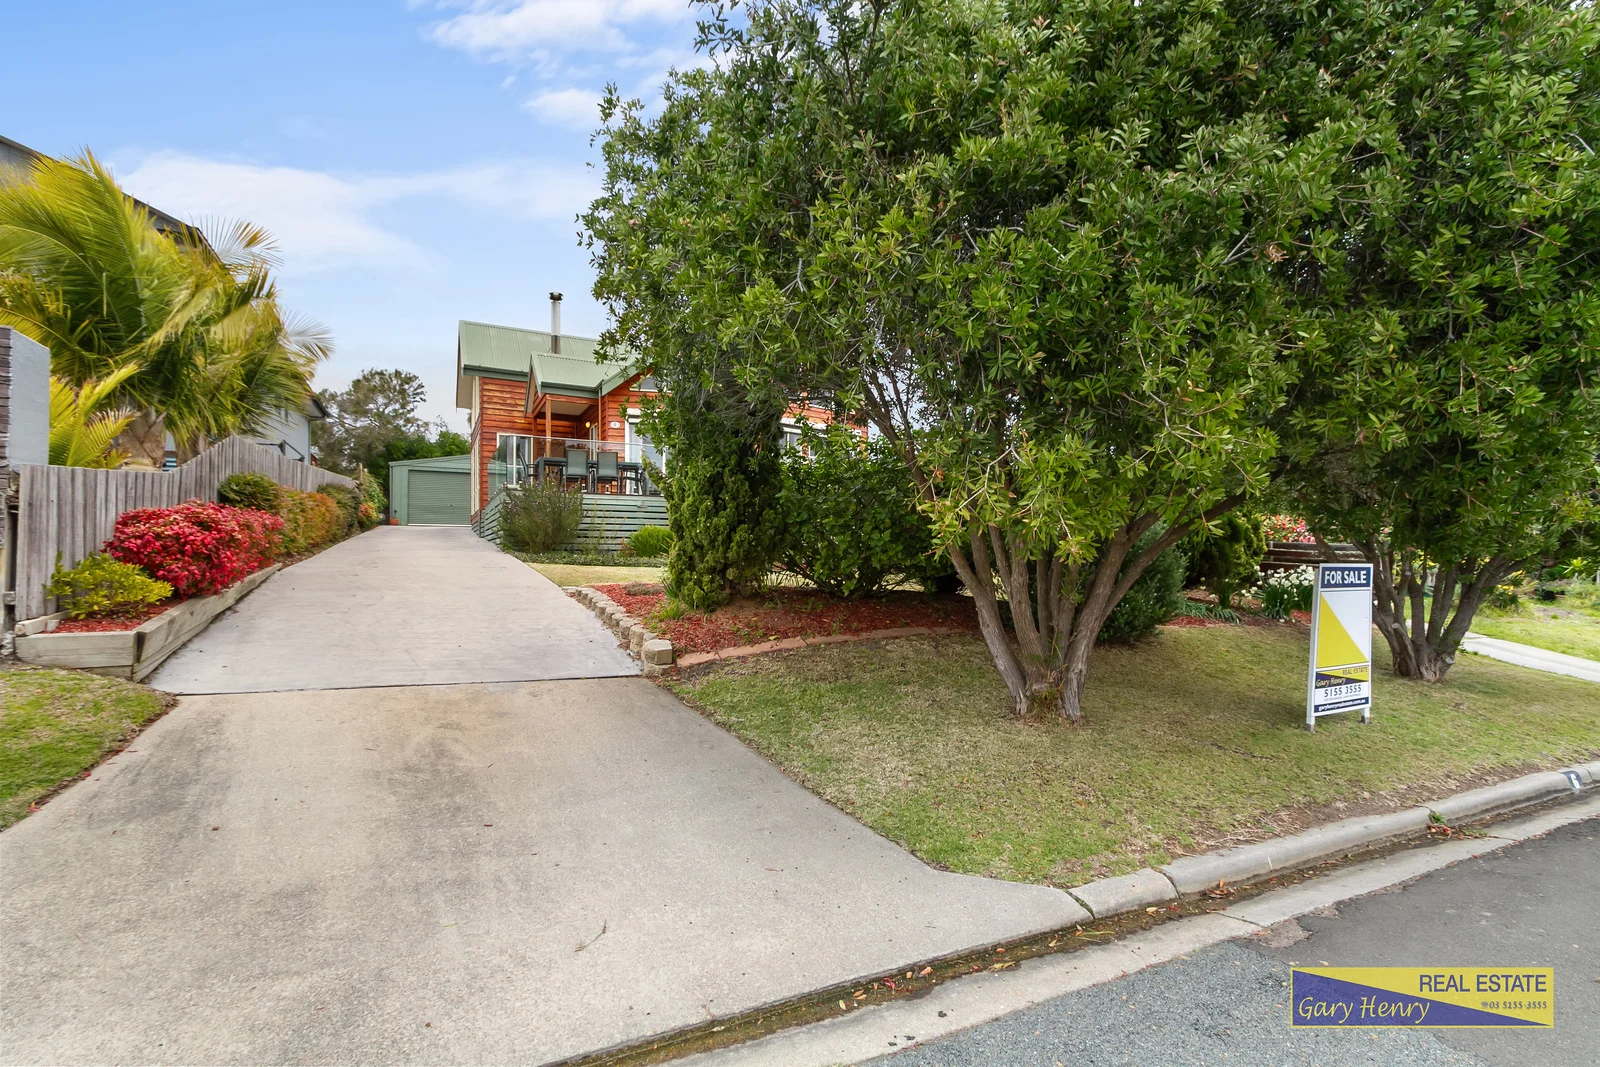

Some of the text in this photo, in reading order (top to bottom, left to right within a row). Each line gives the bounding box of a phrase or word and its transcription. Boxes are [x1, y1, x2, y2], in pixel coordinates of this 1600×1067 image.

[1324, 570, 1367, 584] FOR SALE
[1316, 677, 1346, 687] Gary Henry
[1324, 687, 1342, 698] 5155
[1345, 684, 1361, 695] 3555
